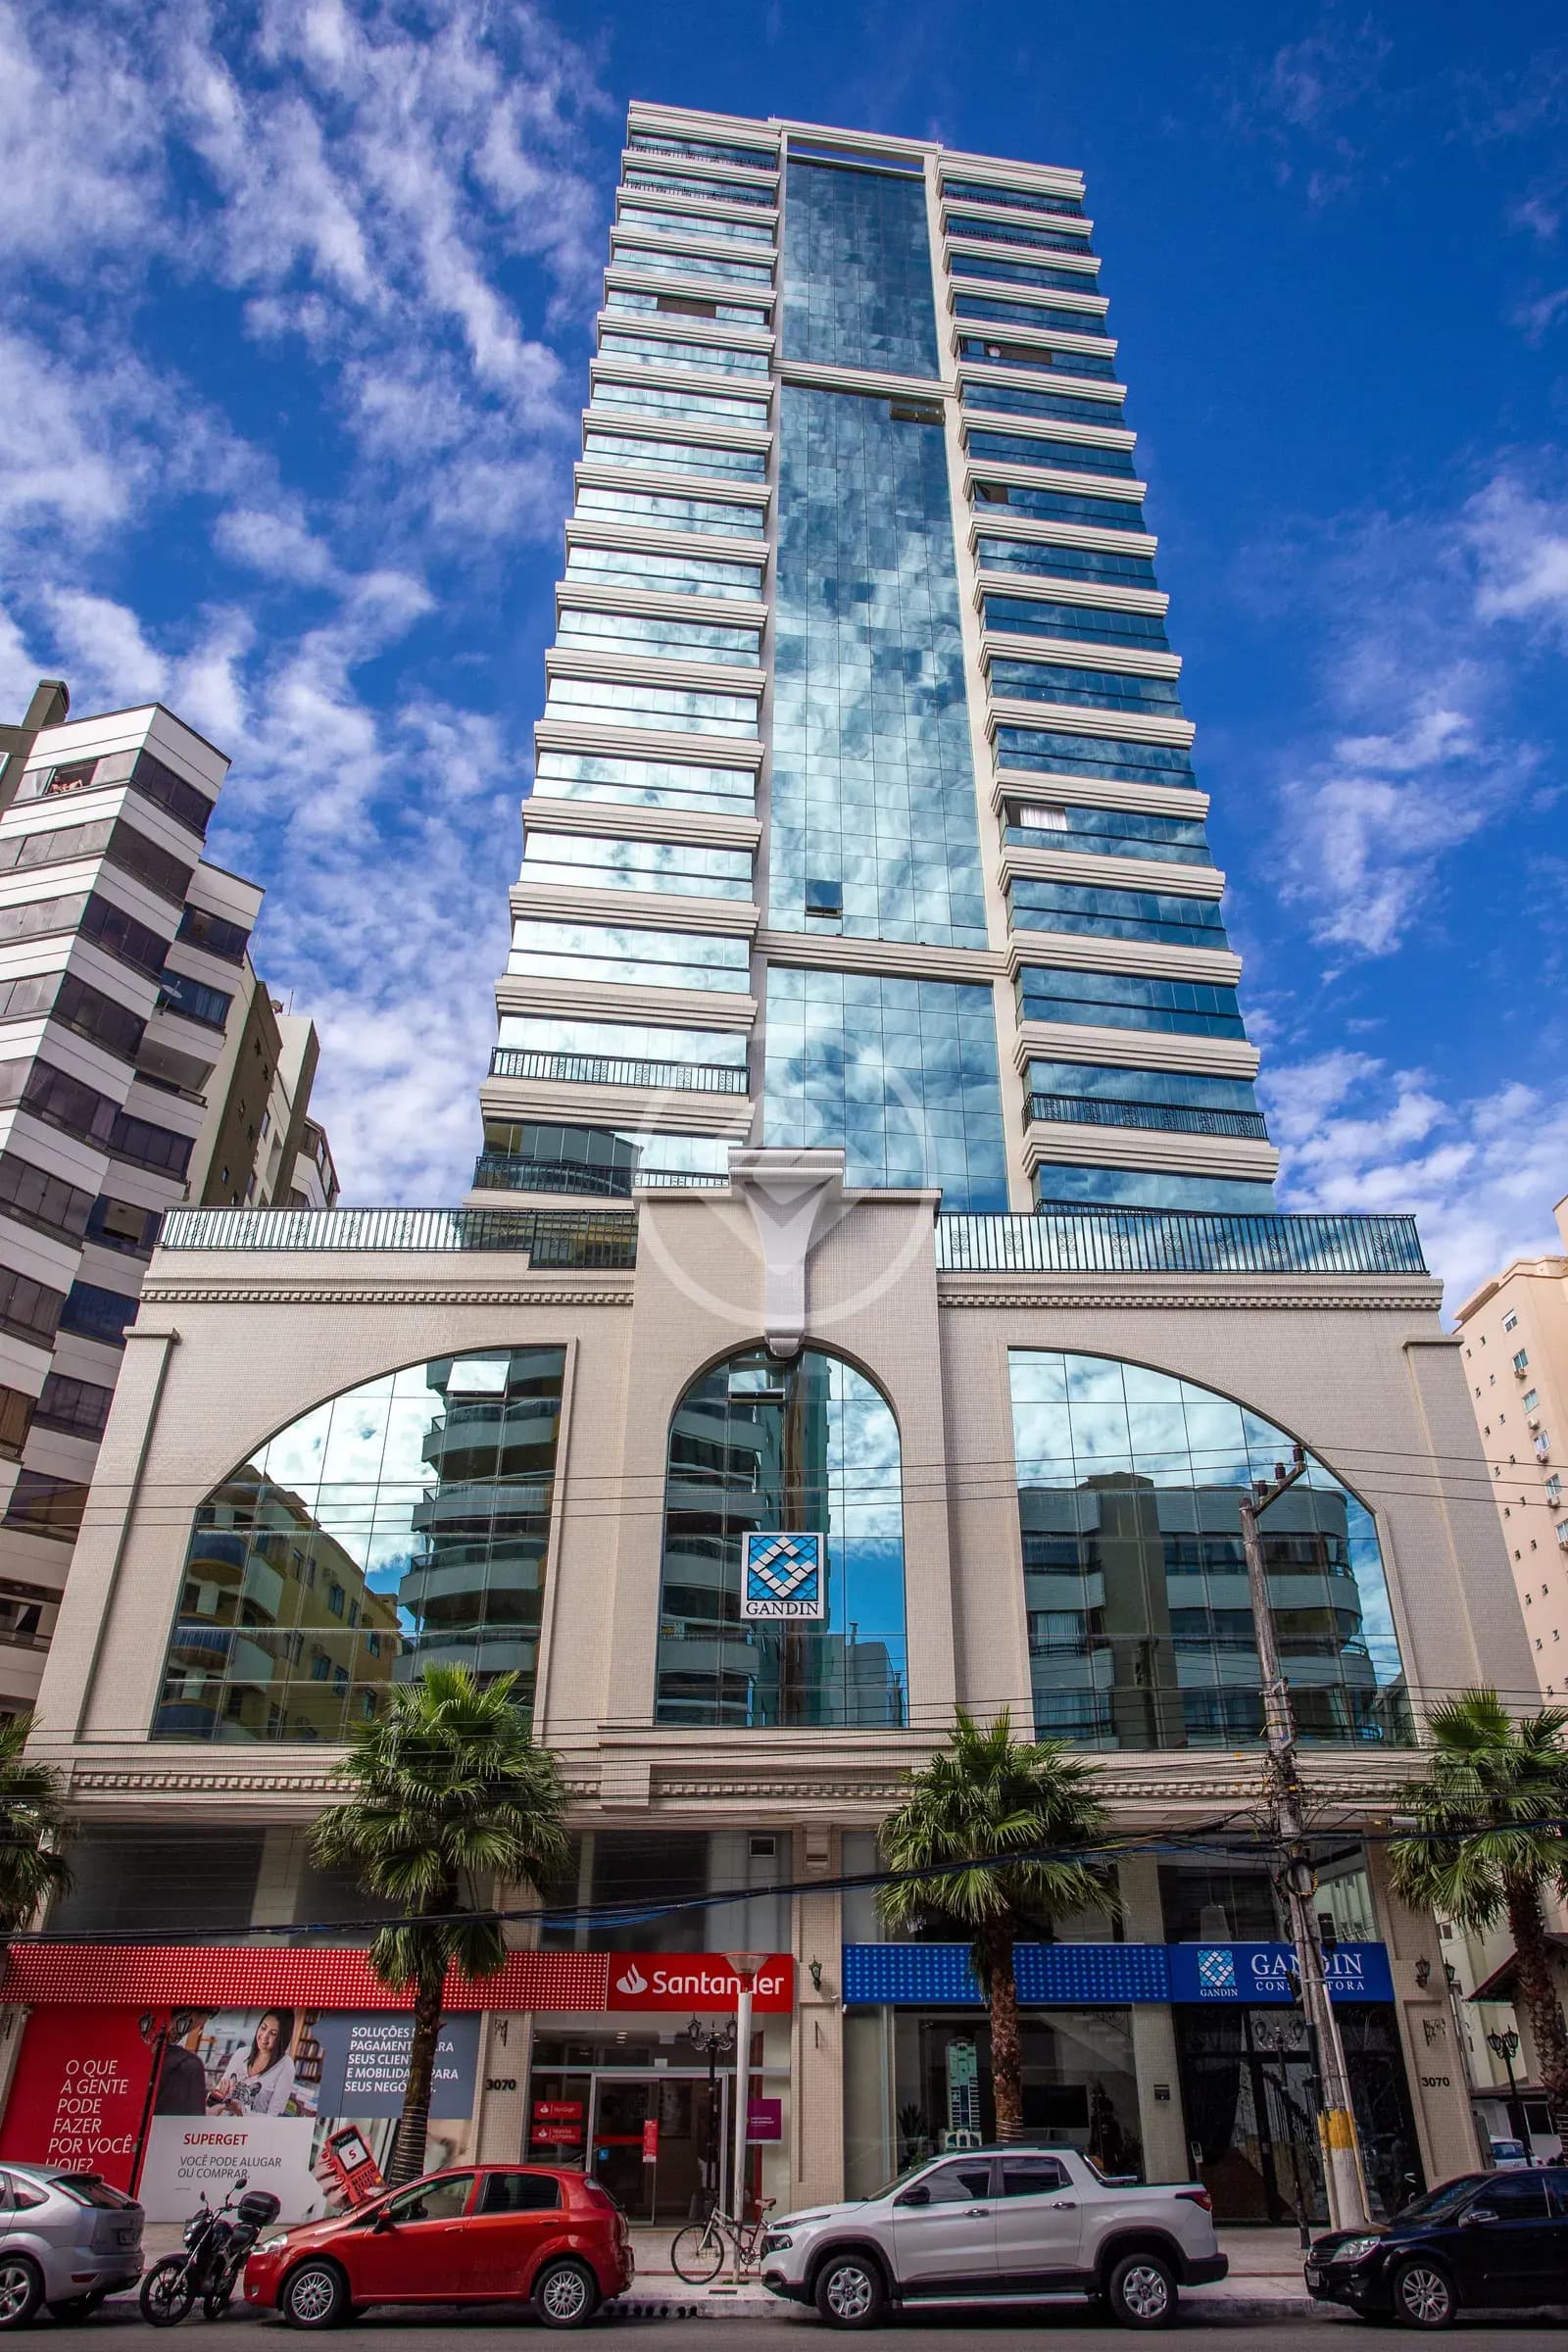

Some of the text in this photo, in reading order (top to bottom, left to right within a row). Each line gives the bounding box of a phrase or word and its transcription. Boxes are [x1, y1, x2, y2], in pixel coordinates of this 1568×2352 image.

[746, 1601, 819, 1616] GANDIN
[1200, 1987, 1239, 1997] GANDIN
[1255, 1980, 1365, 1991] CONTORA
[351, 2025, 410, 2040] SOLUÇÕES
[349, 2040, 413, 2052] PAGAMENT
[347, 2053, 413, 2066] SEUS CLIEN
[66, 2059, 119, 2078] O QUE
[346, 2067, 353, 2079] E
[355, 2067, 412, 2079] MOBILIDA
[60, 2079, 129, 2094] A GENTE
[344, 2081, 372, 2092] SEUS
[485, 2079, 516, 2091] 3070
[1420, 2077, 1450, 2087] 3070
[57, 2098, 103, 2114] PODE
[52, 2118, 103, 2133] FAZER
[48, 2133, 132, 2154] POR VOCÊ
[183, 2132, 249, 2146] SUPERGET
[179, 2153, 282, 2168] VOCÊ PODE ALUGAR
[177, 2167, 251, 2180] OU COMPRAR.
